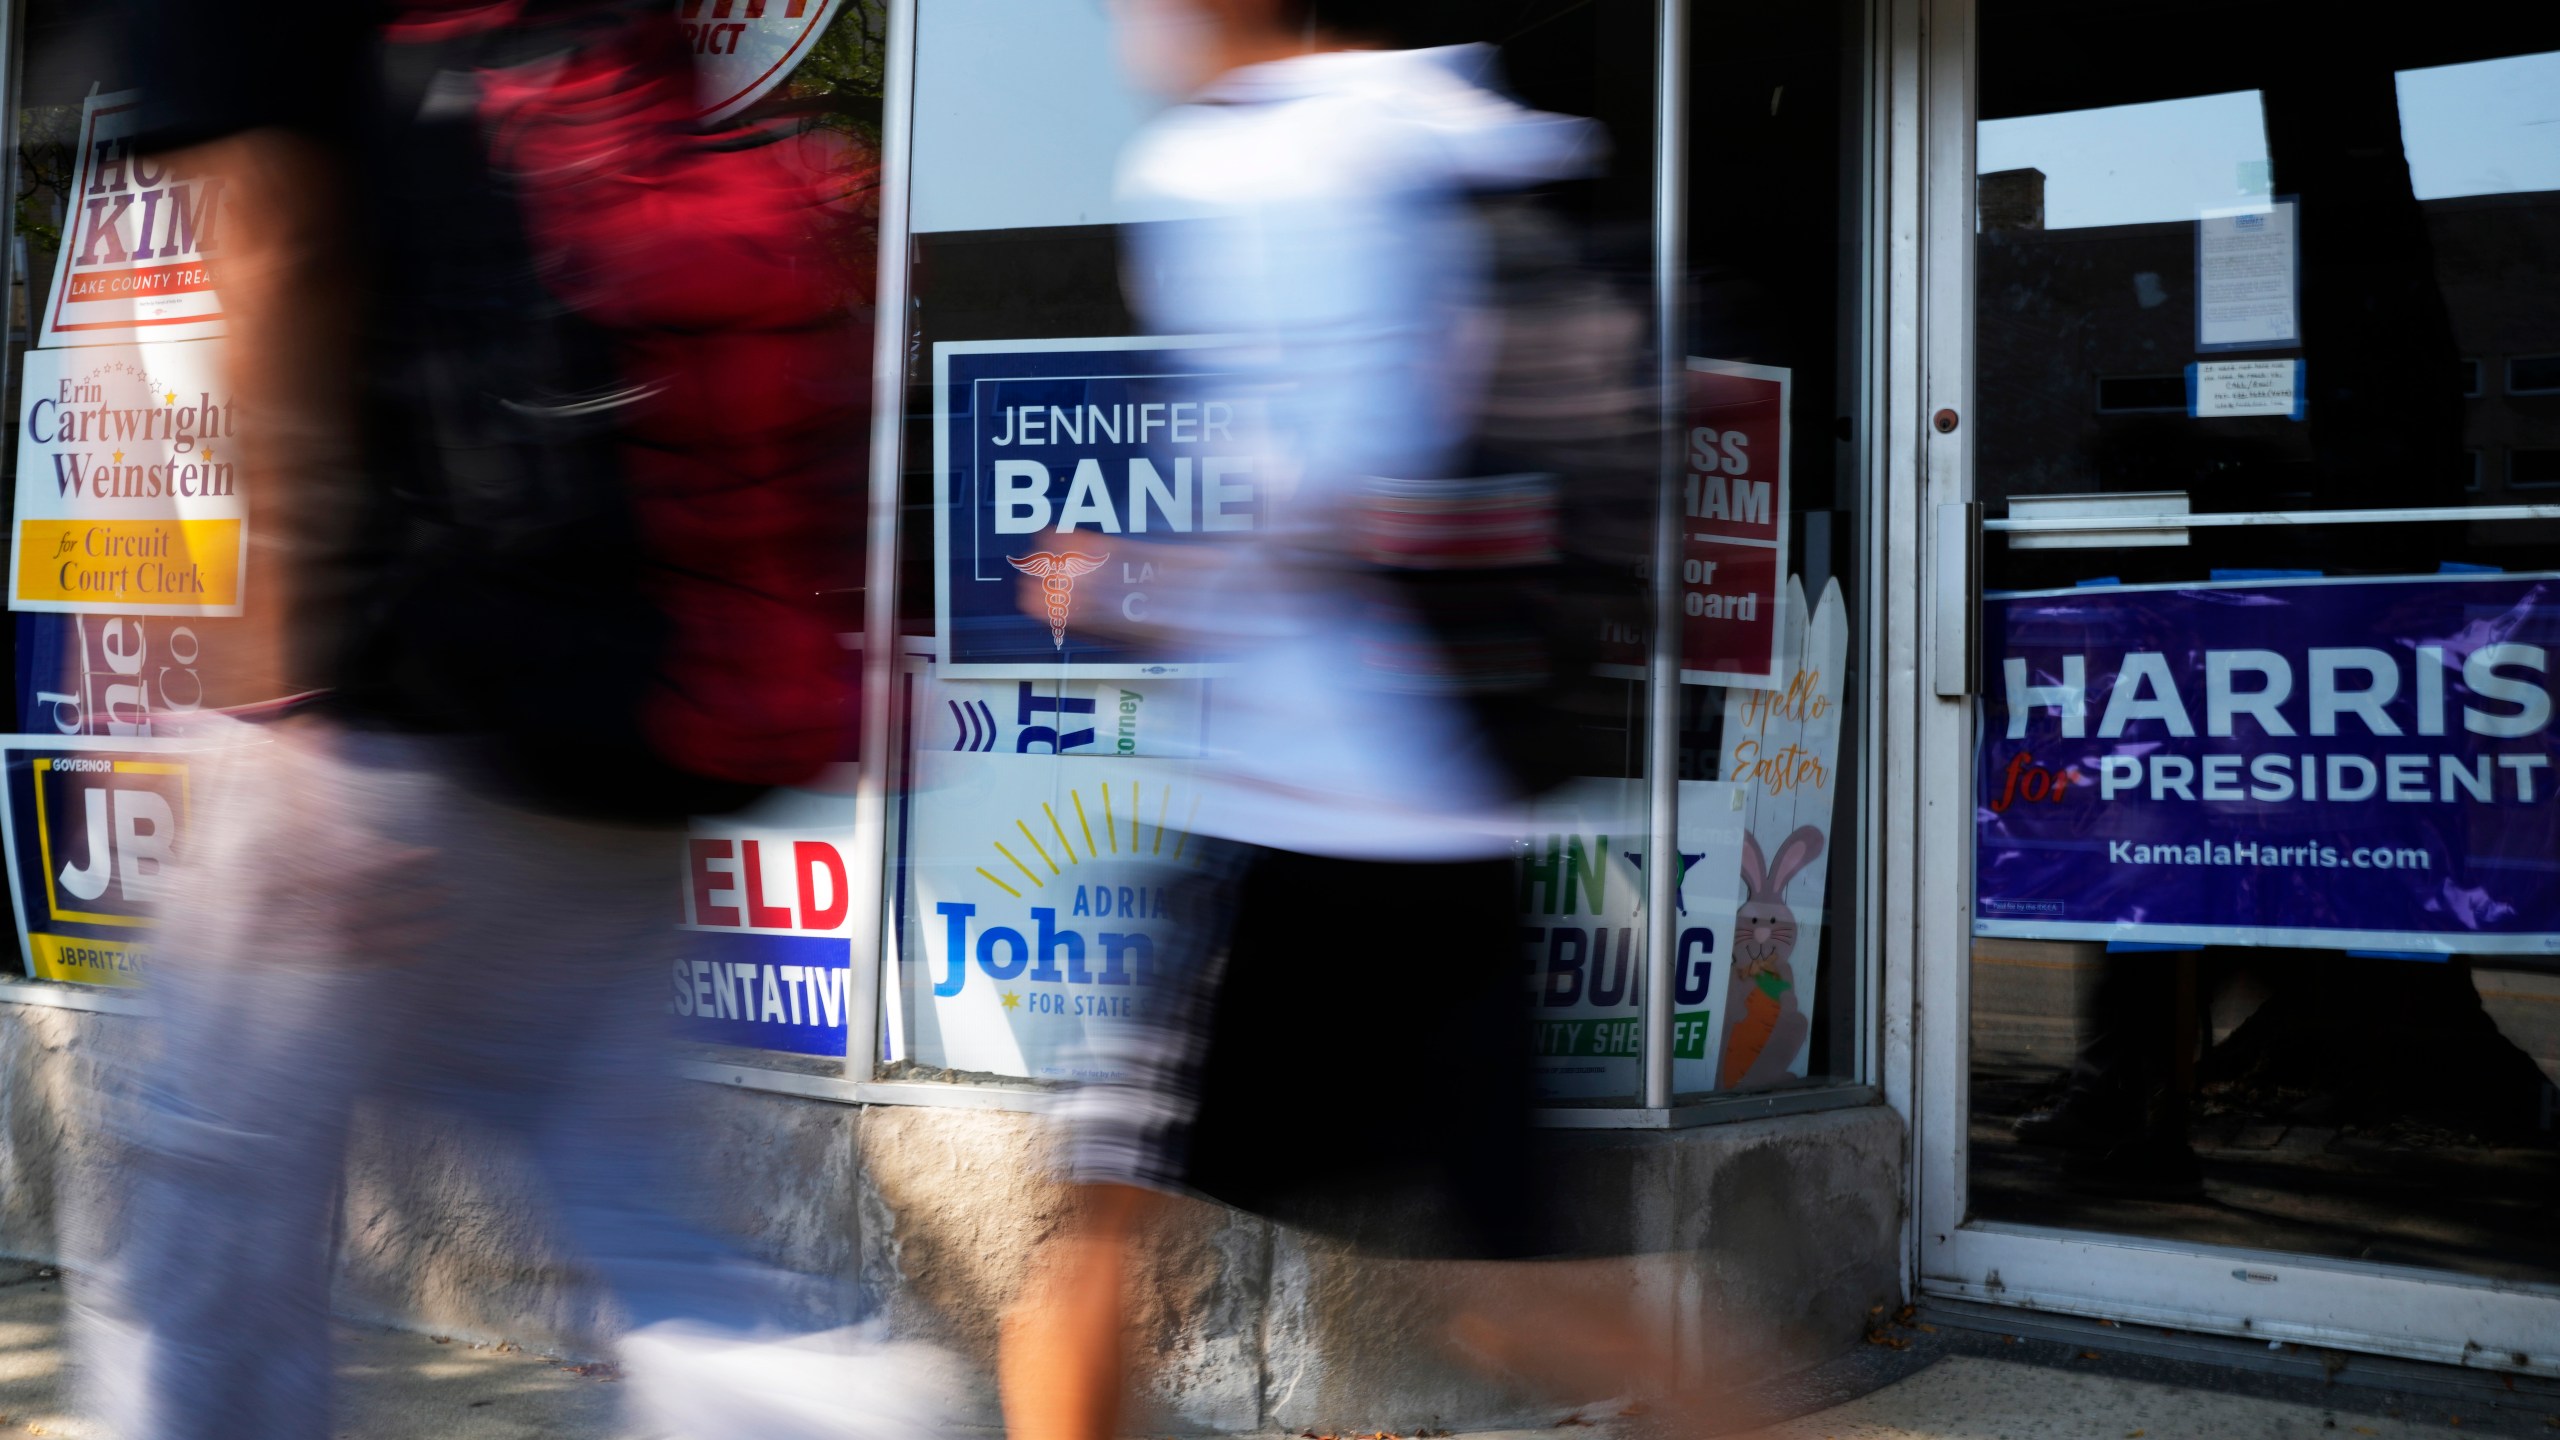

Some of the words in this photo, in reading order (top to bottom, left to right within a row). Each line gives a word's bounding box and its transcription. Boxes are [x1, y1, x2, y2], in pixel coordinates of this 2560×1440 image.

[681, 23, 748, 55] RICT
[75, 179, 225, 267] KIM
[71, 279, 105, 295] LAKE
[111, 267, 171, 292] COUNTY
[58, 378, 102, 404] Erin
[28, 391, 238, 454] Cartwright
[991, 400, 1234, 447] JENNIFER
[52, 449, 235, 499] Weinstein
[1685, 426, 1750, 476] SS
[994, 455, 1262, 535] BANE
[53, 531, 78, 559] for
[84, 526, 170, 557] Circuit
[59, 561, 129, 592] Court
[136, 563, 205, 594] Clerk
[1685, 592, 1758, 622] oard
[1740, 670, 1832, 738] Hello
[2003, 643, 2553, 739] HARRIS
[52, 760, 112, 773] GOVERNOR
[1730, 740, 1830, 796] Easter
[1992, 750, 2079, 813] for
[2100, 752, 2549, 802] PRESIDENT
[58, 787, 176, 901] JB
[2108, 839, 2430, 869] KamalaHarris.com
[933, 901, 1158, 998] John
[1028, 992, 1065, 1015] FOR
[1074, 994, 1131, 1017] STATE
